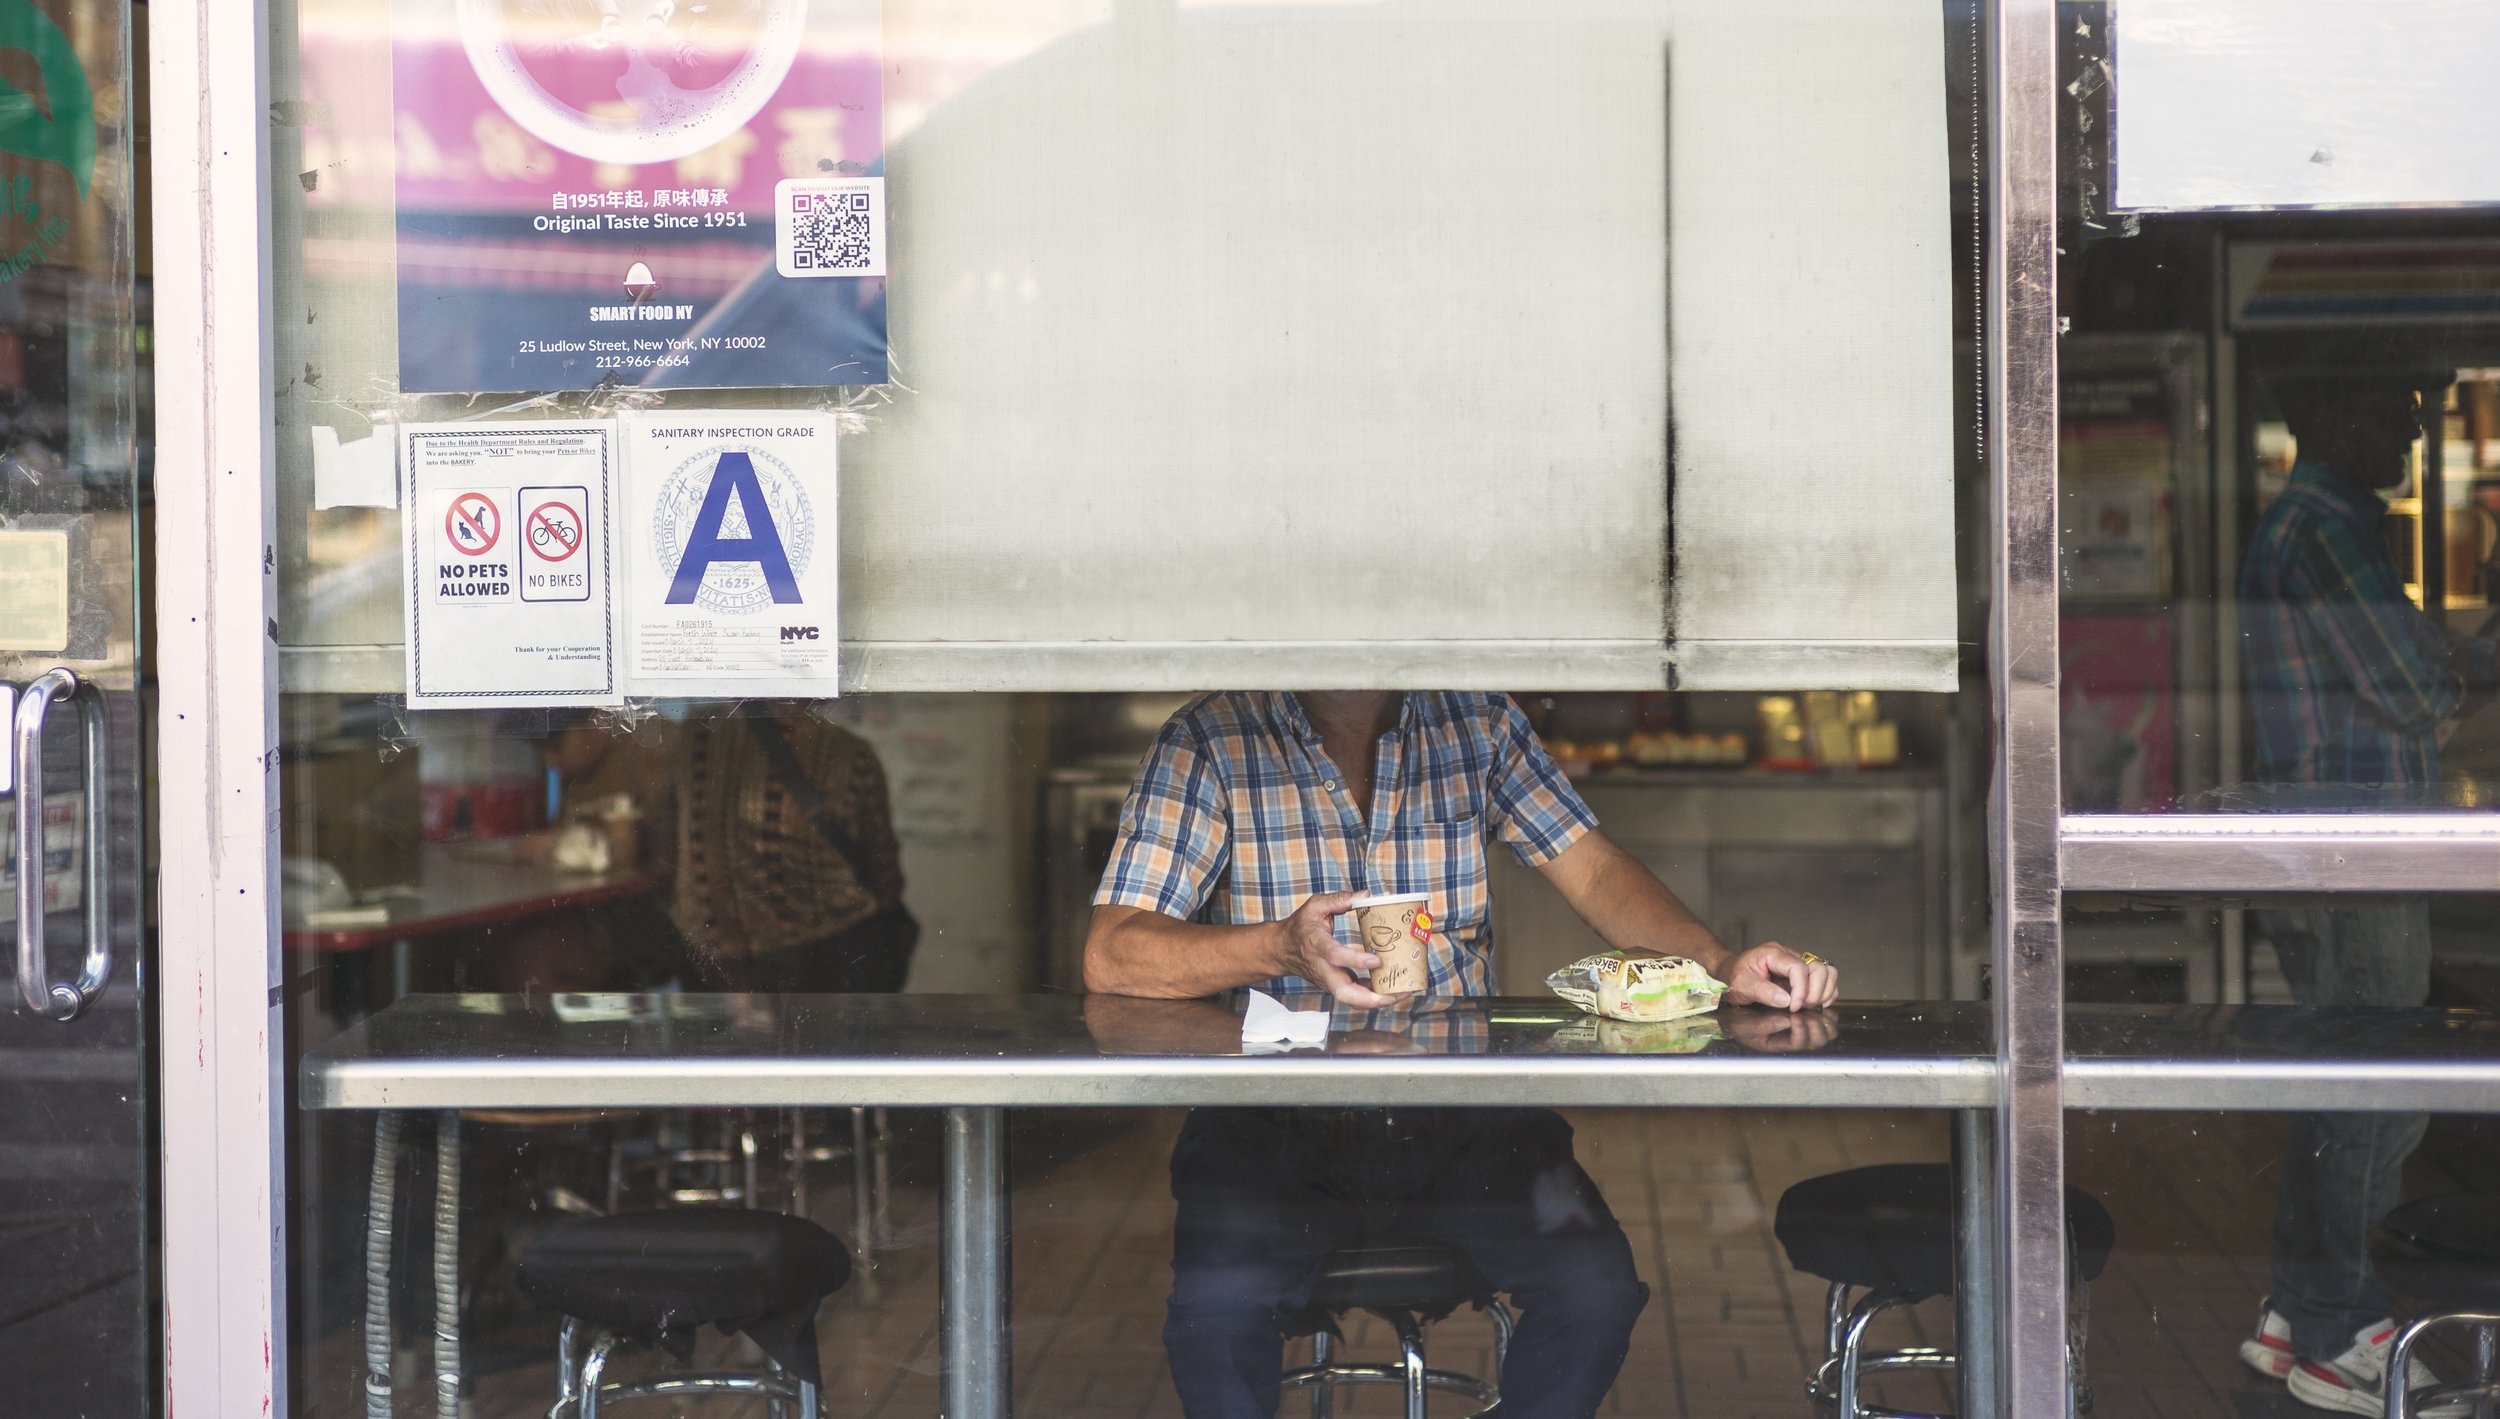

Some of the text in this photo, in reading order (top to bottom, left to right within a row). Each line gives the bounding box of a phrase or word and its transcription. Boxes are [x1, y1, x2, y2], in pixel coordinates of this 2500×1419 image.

[533, 211, 747, 233] Original Taste Since 1951
[0, 239, 48, 282] akery
[590, 305, 693, 322] SMART FOOD NY
[519, 337, 766, 353] 25 Ludlow Street, New York, NY 10002
[595, 355, 690, 368] 212-966-6664
[651, 427, 815, 438] SANITARY INSPECTION GRADE
[480, 439, 517, 447] Department
[449, 450, 468, 458] asking
[524, 449, 540, 457] bring
[664, 452, 803, 604] A
[789, 521, 804, 569] BORACI
[439, 564, 508, 578] NO PETS
[529, 574, 582, 587] NO BIKES
[719, 578, 750, 589] 1625
[439, 582, 510, 596] ALLOWED
[700, 585, 755, 606] VITATIS
[780, 626, 819, 640] NYC
[1378, 964, 1408, 988] coffee
